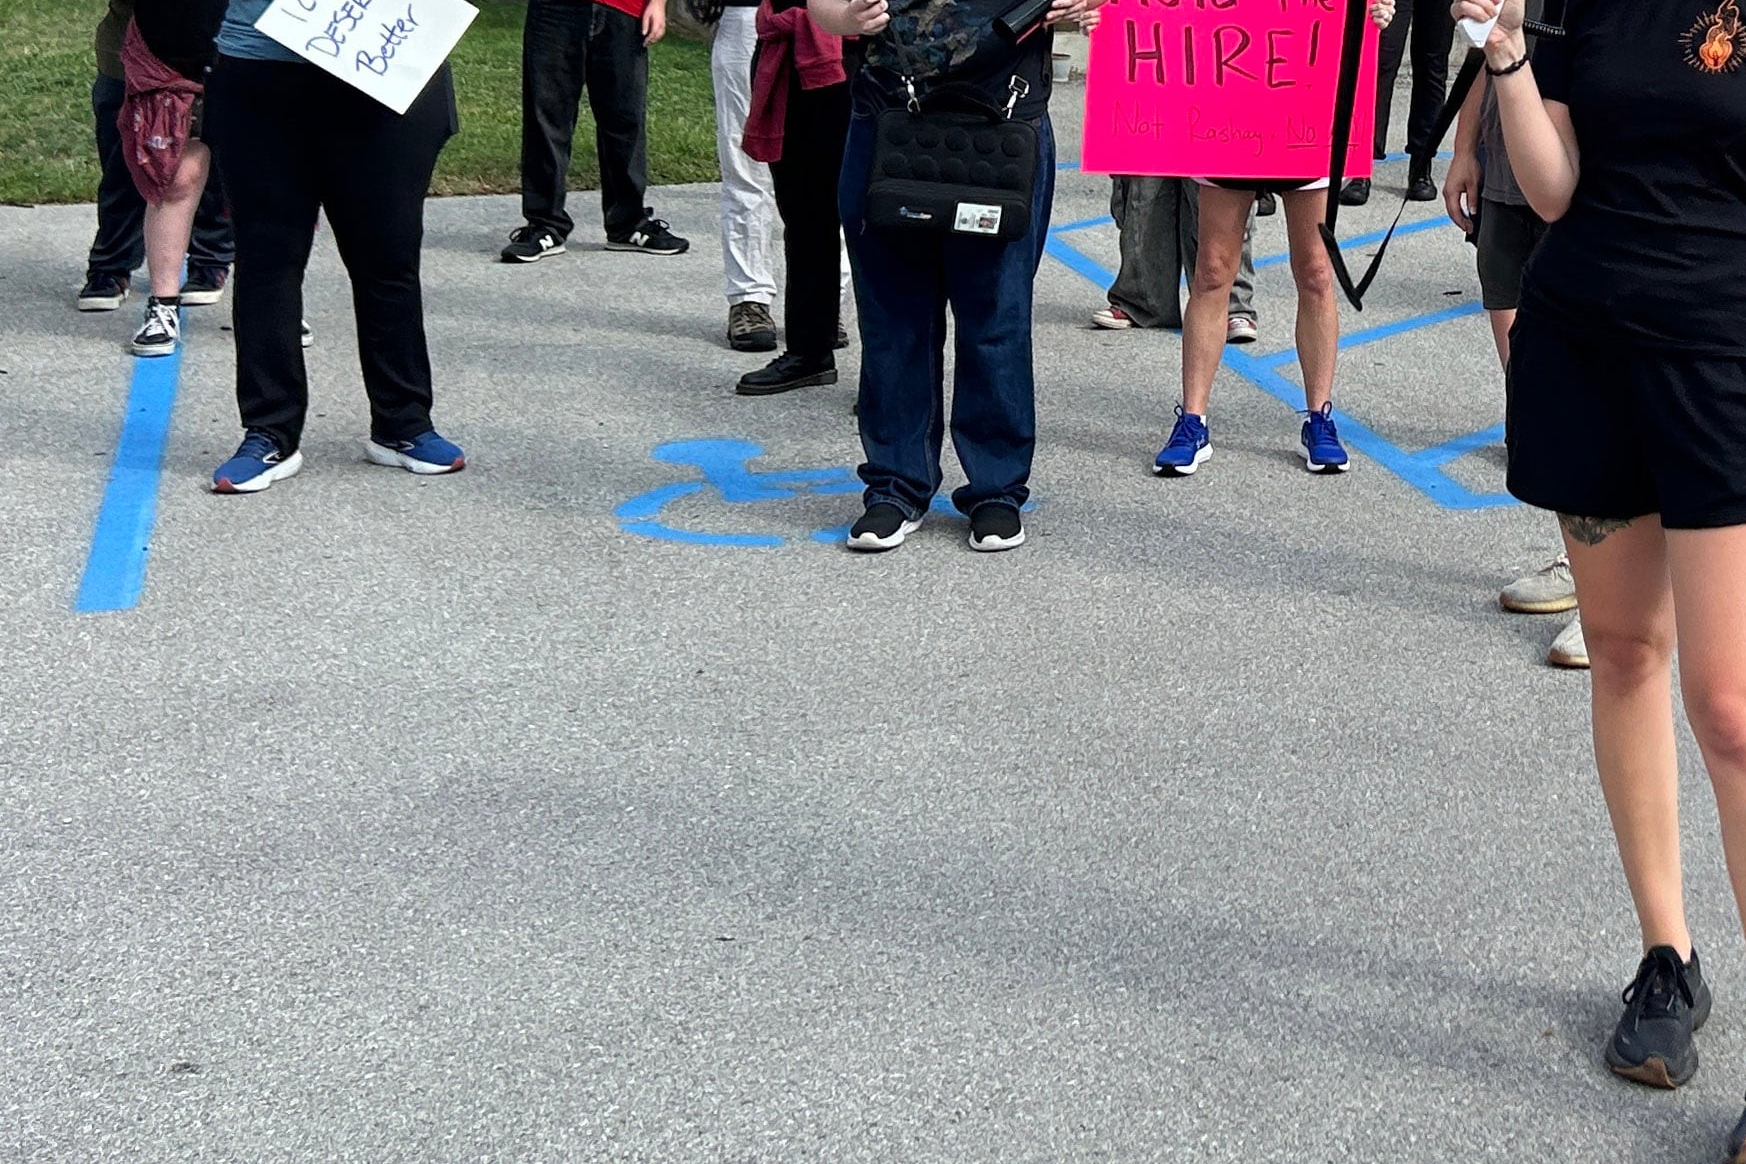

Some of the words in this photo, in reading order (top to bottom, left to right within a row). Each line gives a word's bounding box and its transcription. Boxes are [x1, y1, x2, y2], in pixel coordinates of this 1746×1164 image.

[355, 3, 420, 76] Better
[1126, 20, 1320, 89] HIRE!
[1114, 100, 1165, 136] Not
[1286, 118, 1317, 143] No
